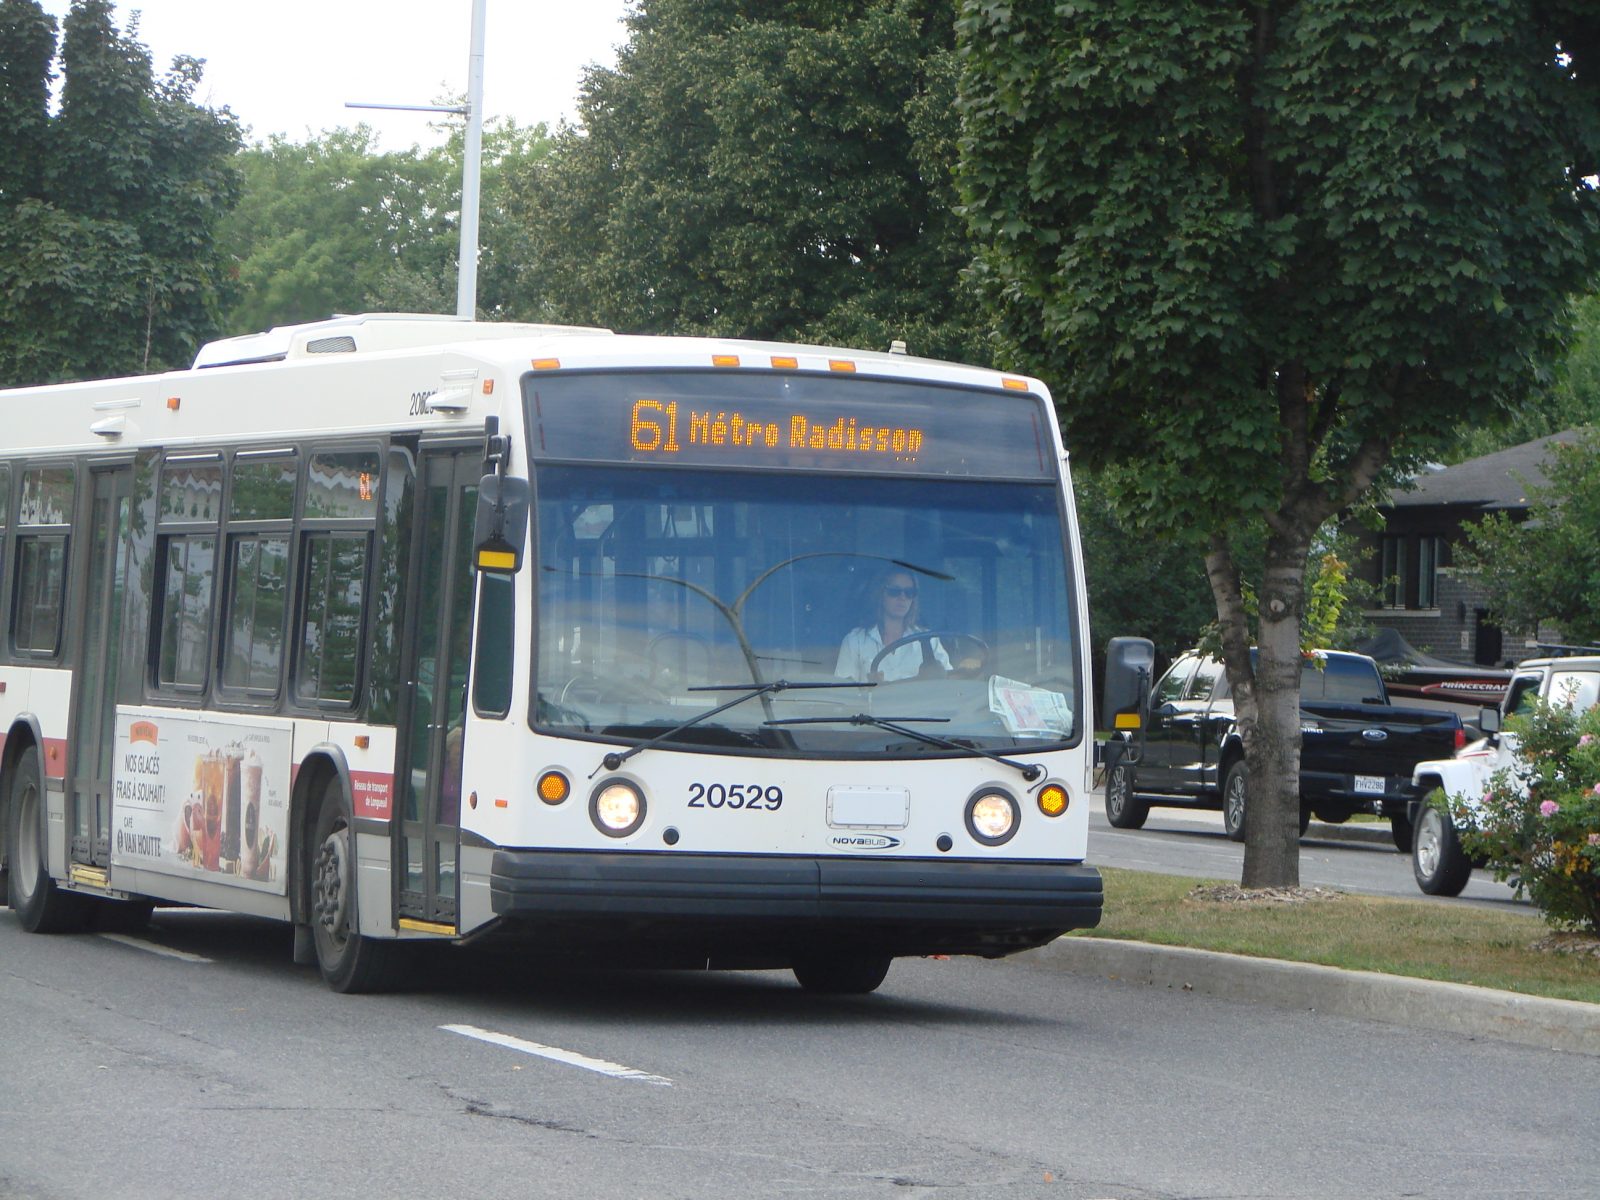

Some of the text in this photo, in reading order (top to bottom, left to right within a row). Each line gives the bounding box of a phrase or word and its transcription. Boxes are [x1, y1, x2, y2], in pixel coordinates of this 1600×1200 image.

[631, 399, 923, 453] 61 Métro Radisson
[360, 473, 371, 500] 61
[1440, 681, 1509, 691] PRINCECRAF
[125, 751, 160, 775] NOS GLACÉS
[115, 780, 131, 799] FRAIS
[687, 783, 783, 811] 20529
[124, 832, 162, 857] VAN HOUTTE
